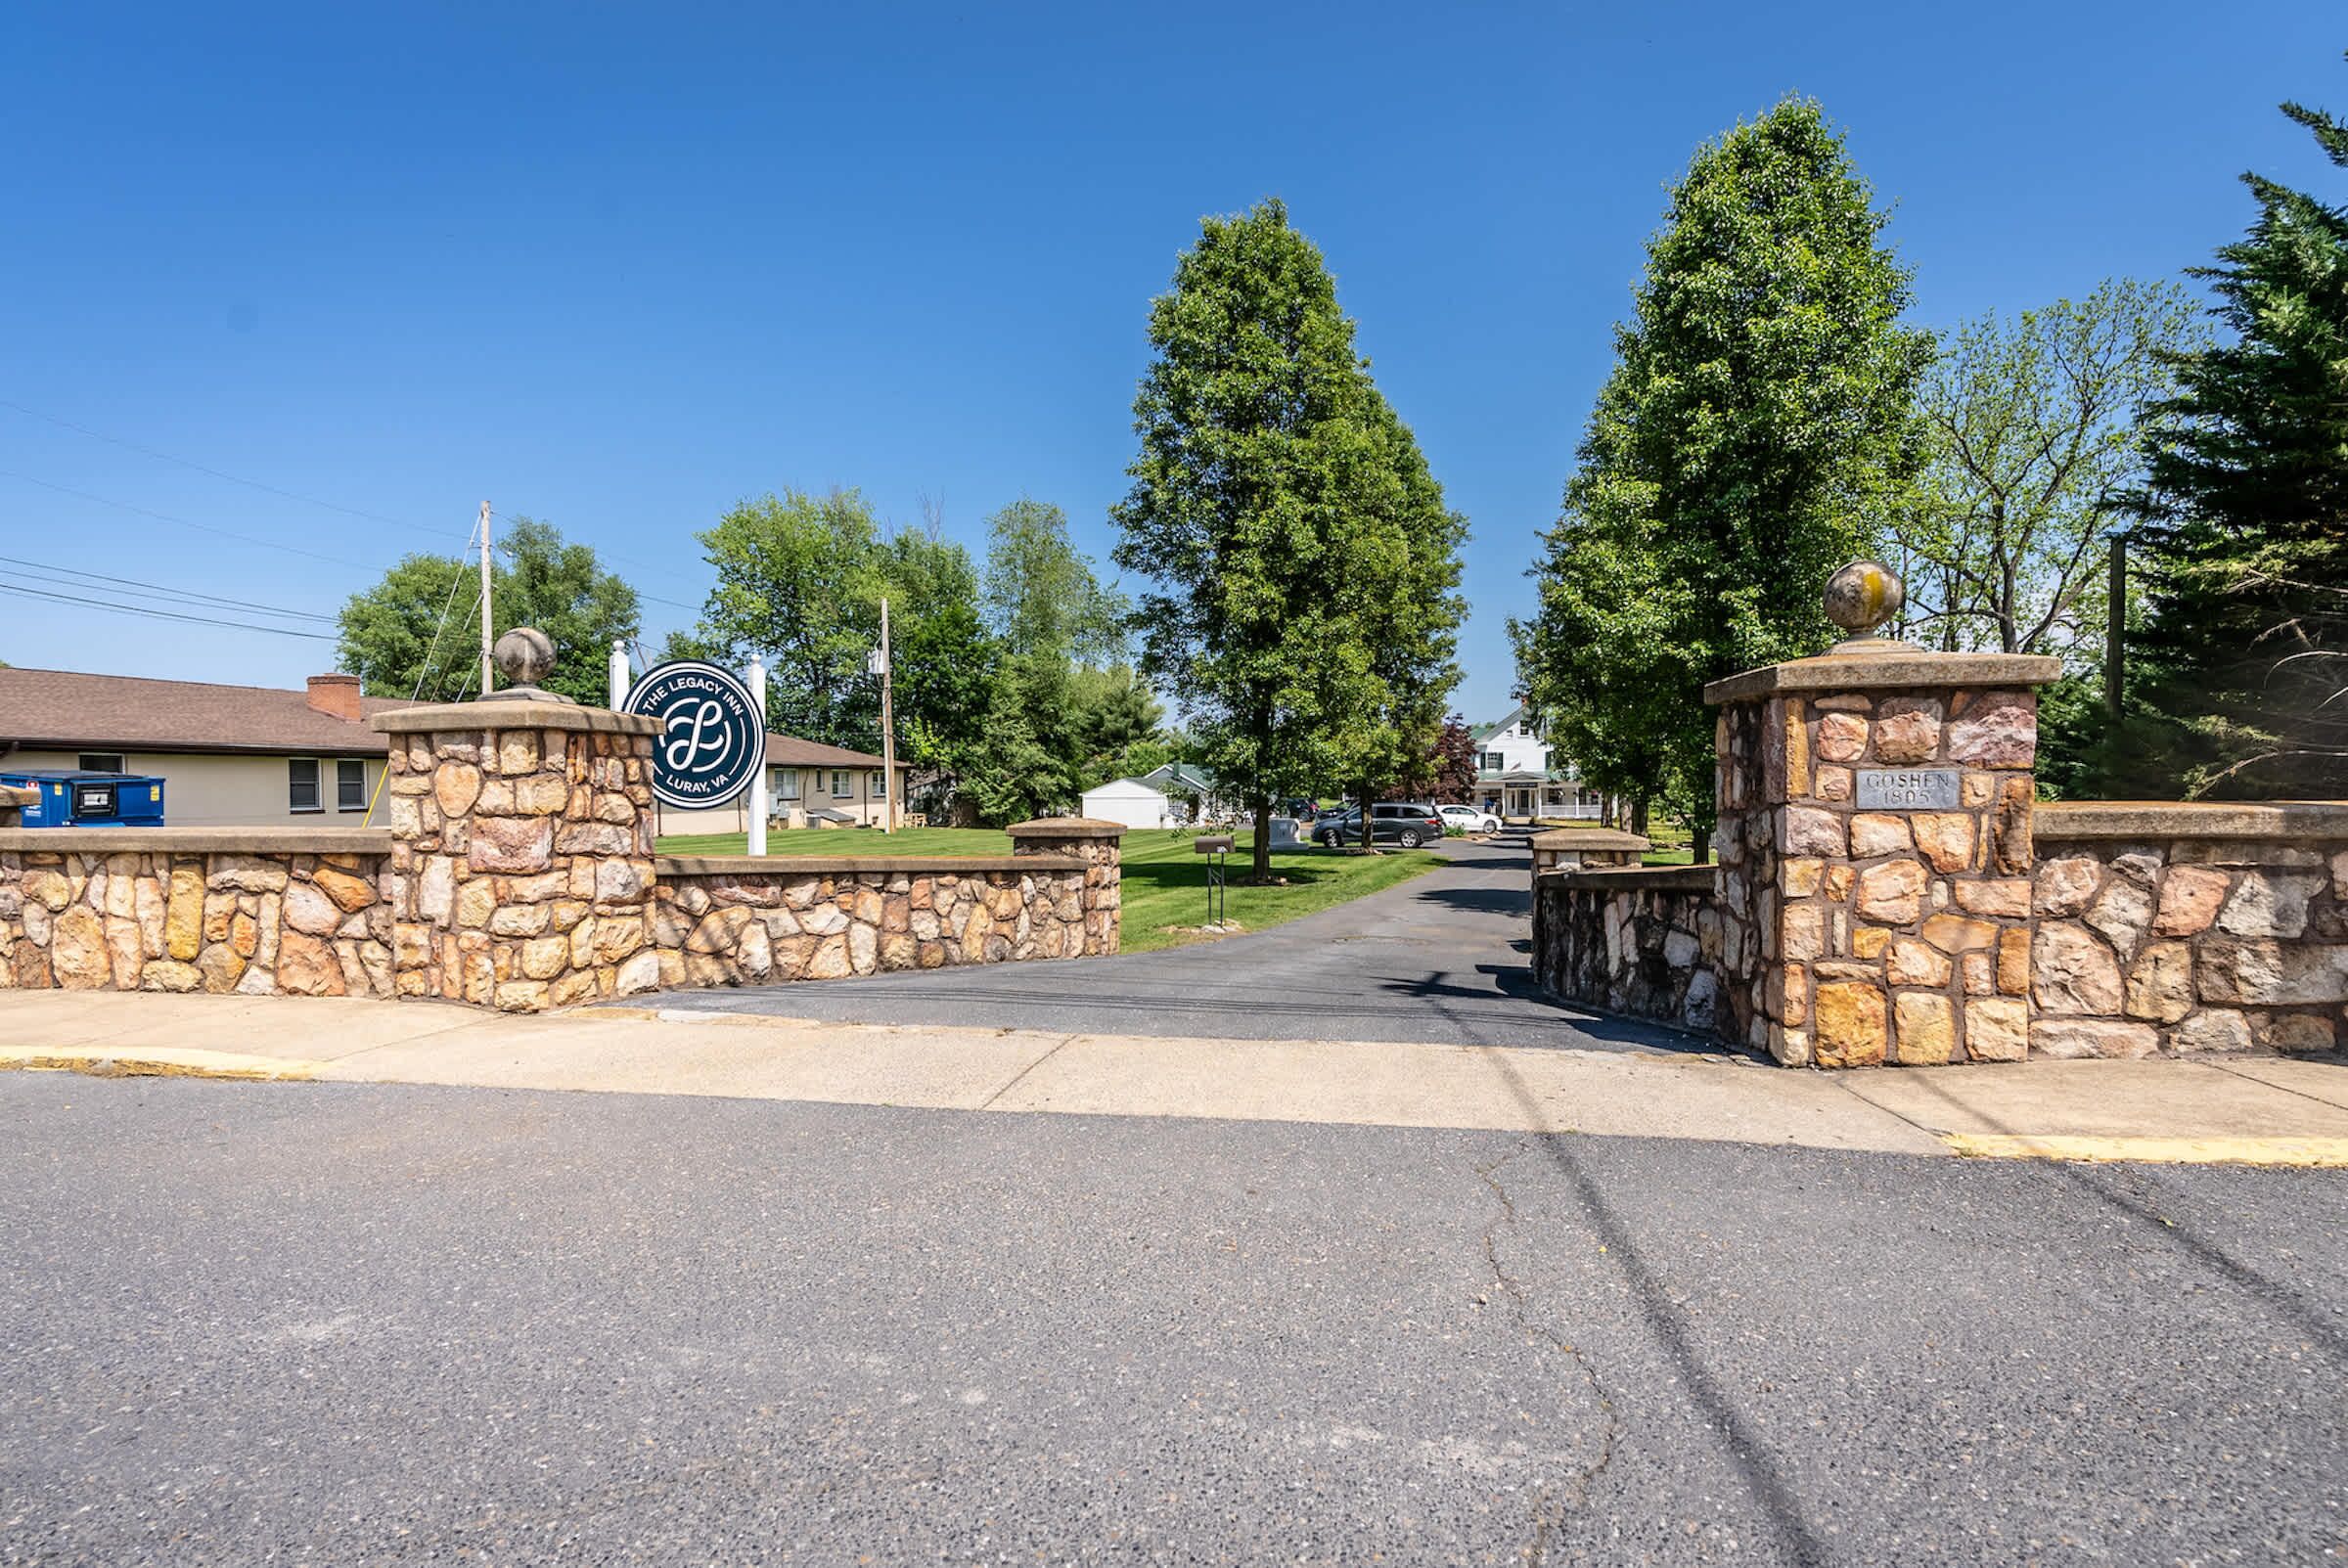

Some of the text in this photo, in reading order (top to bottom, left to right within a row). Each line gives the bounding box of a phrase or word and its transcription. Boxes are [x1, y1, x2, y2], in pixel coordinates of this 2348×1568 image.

[643, 677, 744, 716] THE LEGACY INN
[666, 774, 729, 793] LURAY, VA
[1867, 774, 1949, 788] GOSHEN
